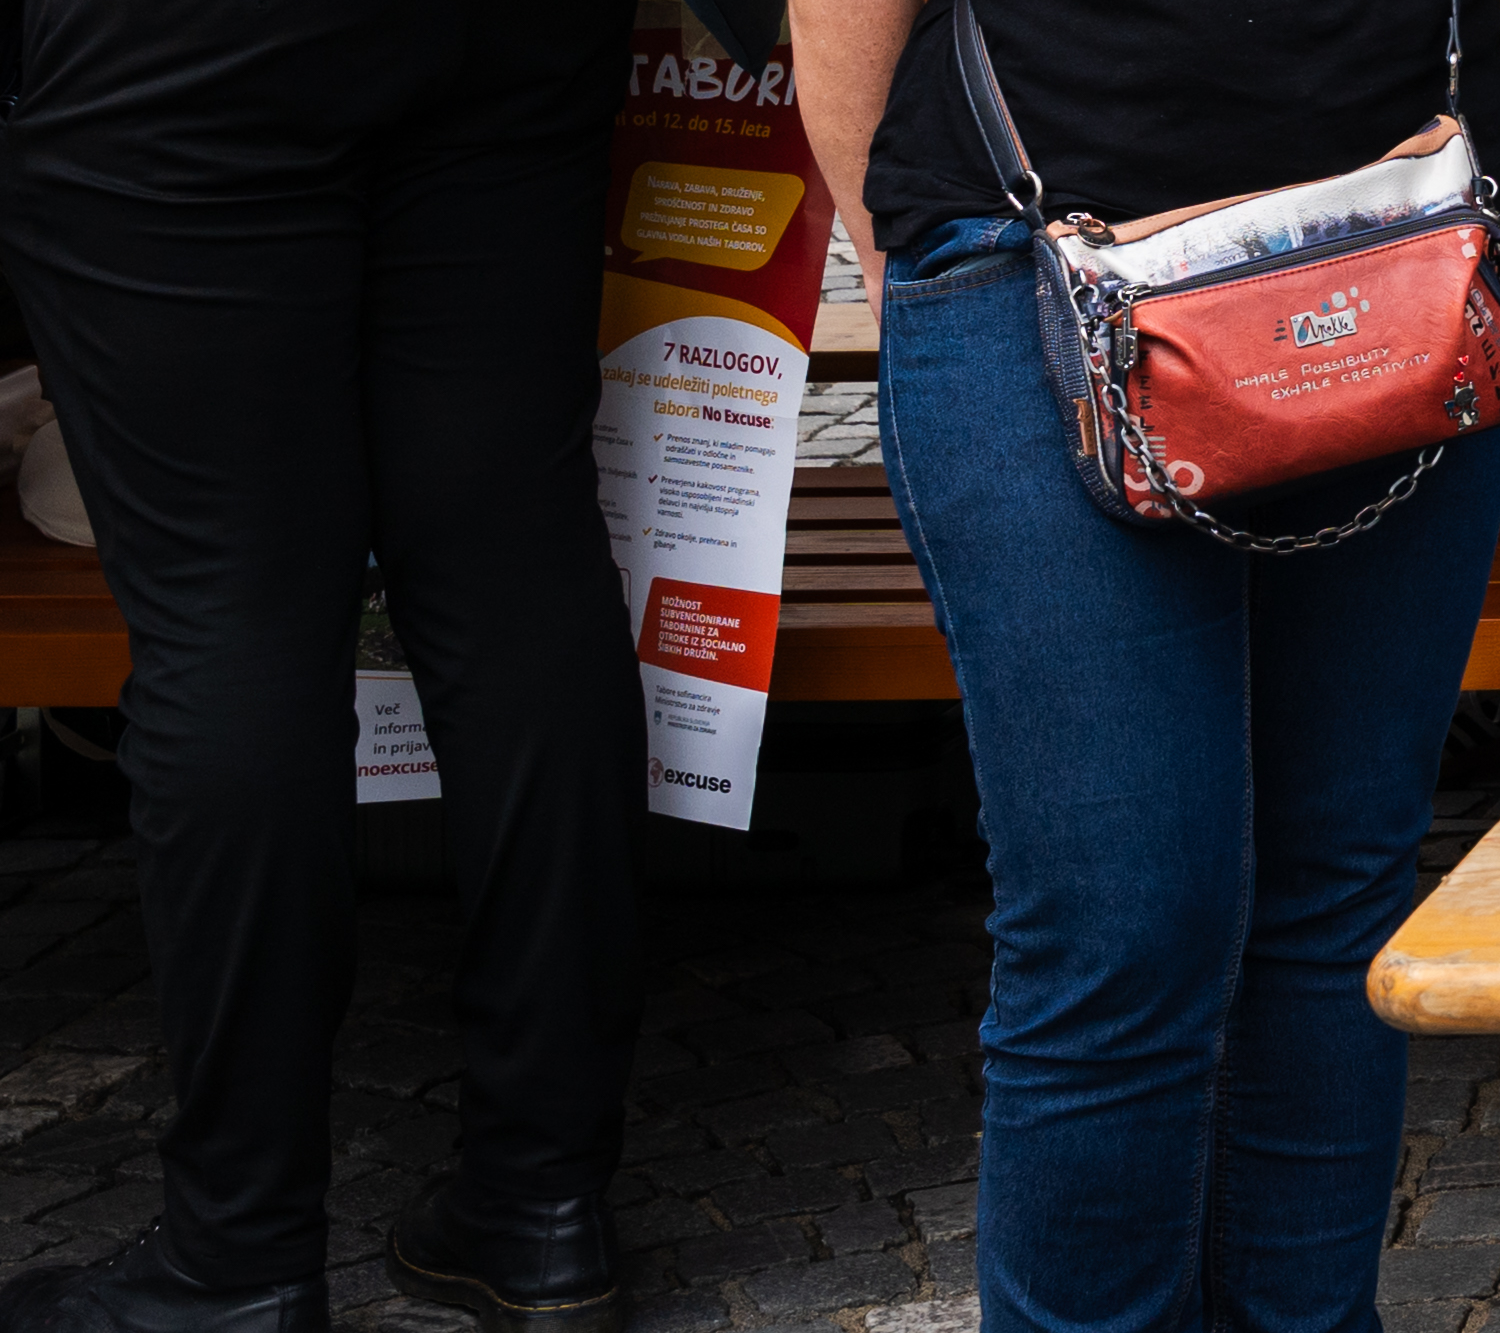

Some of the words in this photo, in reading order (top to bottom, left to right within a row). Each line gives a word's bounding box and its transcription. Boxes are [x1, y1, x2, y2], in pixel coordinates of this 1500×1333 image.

[633, 111, 656, 127] od
[663, 114, 683, 130] 12.
[689, 115, 708, 132] do
[715, 118, 735, 135] 15.
[740, 120, 771, 139] leta
[684, 183, 718, 197] ZABAVA,
[721, 185, 765, 202] DRUŽENJE,
[654, 195, 706, 211] SPROŠČENOST
[708, 203, 718, 212] IN
[719, 203, 754, 217] ZDRAVO
[689, 217, 730, 231] PROSTEGA
[731, 221, 753, 234] ČASA
[755, 224, 767, 235] SO
[669, 232, 696, 245] VODILA
[697, 234, 722, 248] NAŠIH
[724, 238, 767, 253] TABOROV.
[663, 342, 676, 362] 7
[679, 344, 783, 380] RAZLOGOV,
[1235, 369, 1289, 389] INHALE
[1301, 347, 1390, 376] POSSIBILITY
[603, 366, 636, 388] zakaj
[637, 372, 651, 386] se
[653, 372, 710, 394] udeležiti
[711, 382, 778, 407] poletnega
[1271, 377, 1331, 400] EXHALE
[1341, 353, 1431, 383] CREATIVITY
[653, 399, 700, 419] tabora
[702, 405, 722, 422] No
[725, 409, 775, 430] Excuse:
[667, 433, 690, 444] Prenos
[720, 440, 744, 451] mladim
[744, 444, 776, 457] pomagajo
[659, 486, 680, 497] visoko
[696, 480, 727, 493] kakovost
[654, 528, 676, 539] Zdravo
[699, 535, 729, 547] prehrana
[661, 595, 702, 610] MOŽNOST
[660, 608, 741, 628] SUBVENCIONIRANE
[659, 619, 706, 636] TABORNINE
[707, 627, 719, 638] ZA
[657, 641, 682, 656] ŠIBKIH
[683, 645, 719, 661] DRUŽIN.
[658, 631, 689, 646] OTROKE
[690, 636, 700, 646] IZ
[700, 637, 746, 653] SOCIALNO
[655, 684, 676, 697] Tabore
[676, 689, 712, 703] sofinancira
[375, 703, 401, 716] Več
[655, 696, 687, 711] Ministrstvo
[688, 703, 696, 711] za
[696, 703, 721, 717] zdravje
[373, 743, 386, 755] in
